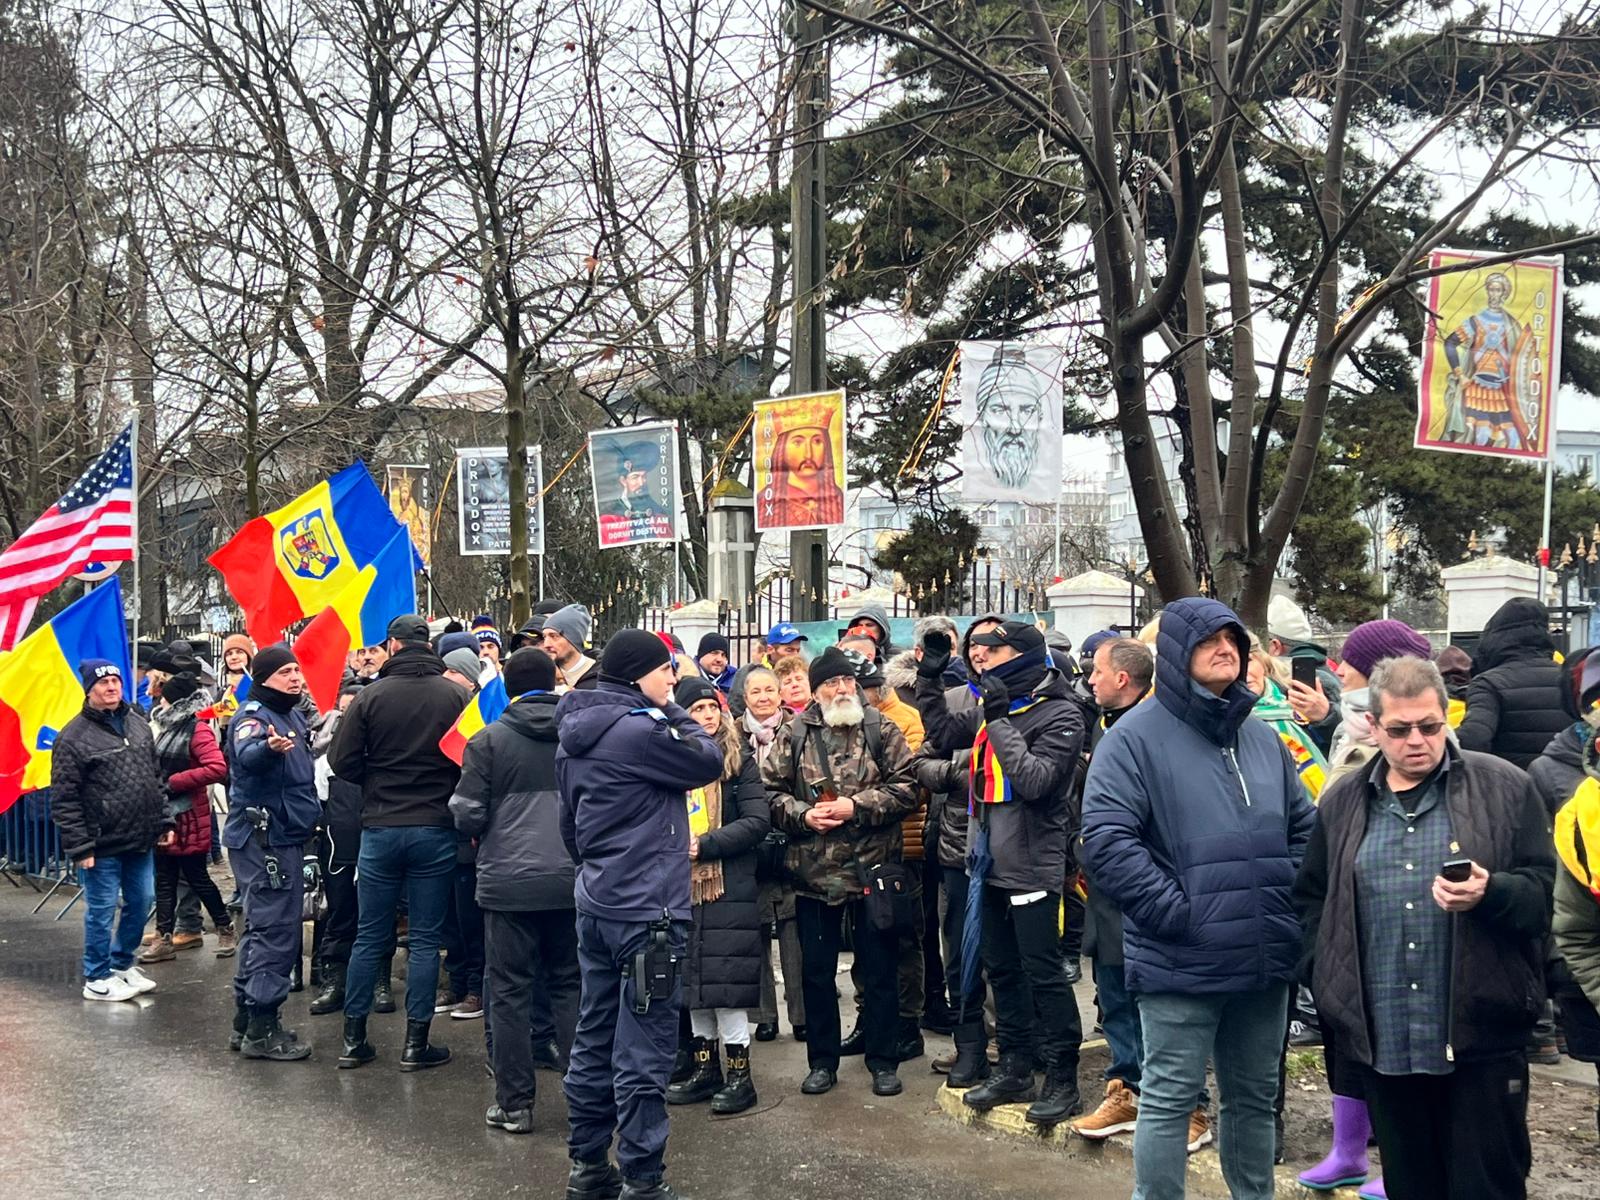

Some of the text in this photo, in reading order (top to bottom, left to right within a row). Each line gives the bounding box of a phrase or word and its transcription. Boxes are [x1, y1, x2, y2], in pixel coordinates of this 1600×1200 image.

[1526, 290, 1545, 441] ORTODOX
[469, 458, 481, 545] ORTODOX
[659, 434, 669, 507] ORTODOX
[763, 410, 775, 517] ORTODOX
[656, 516, 669, 525] AM
